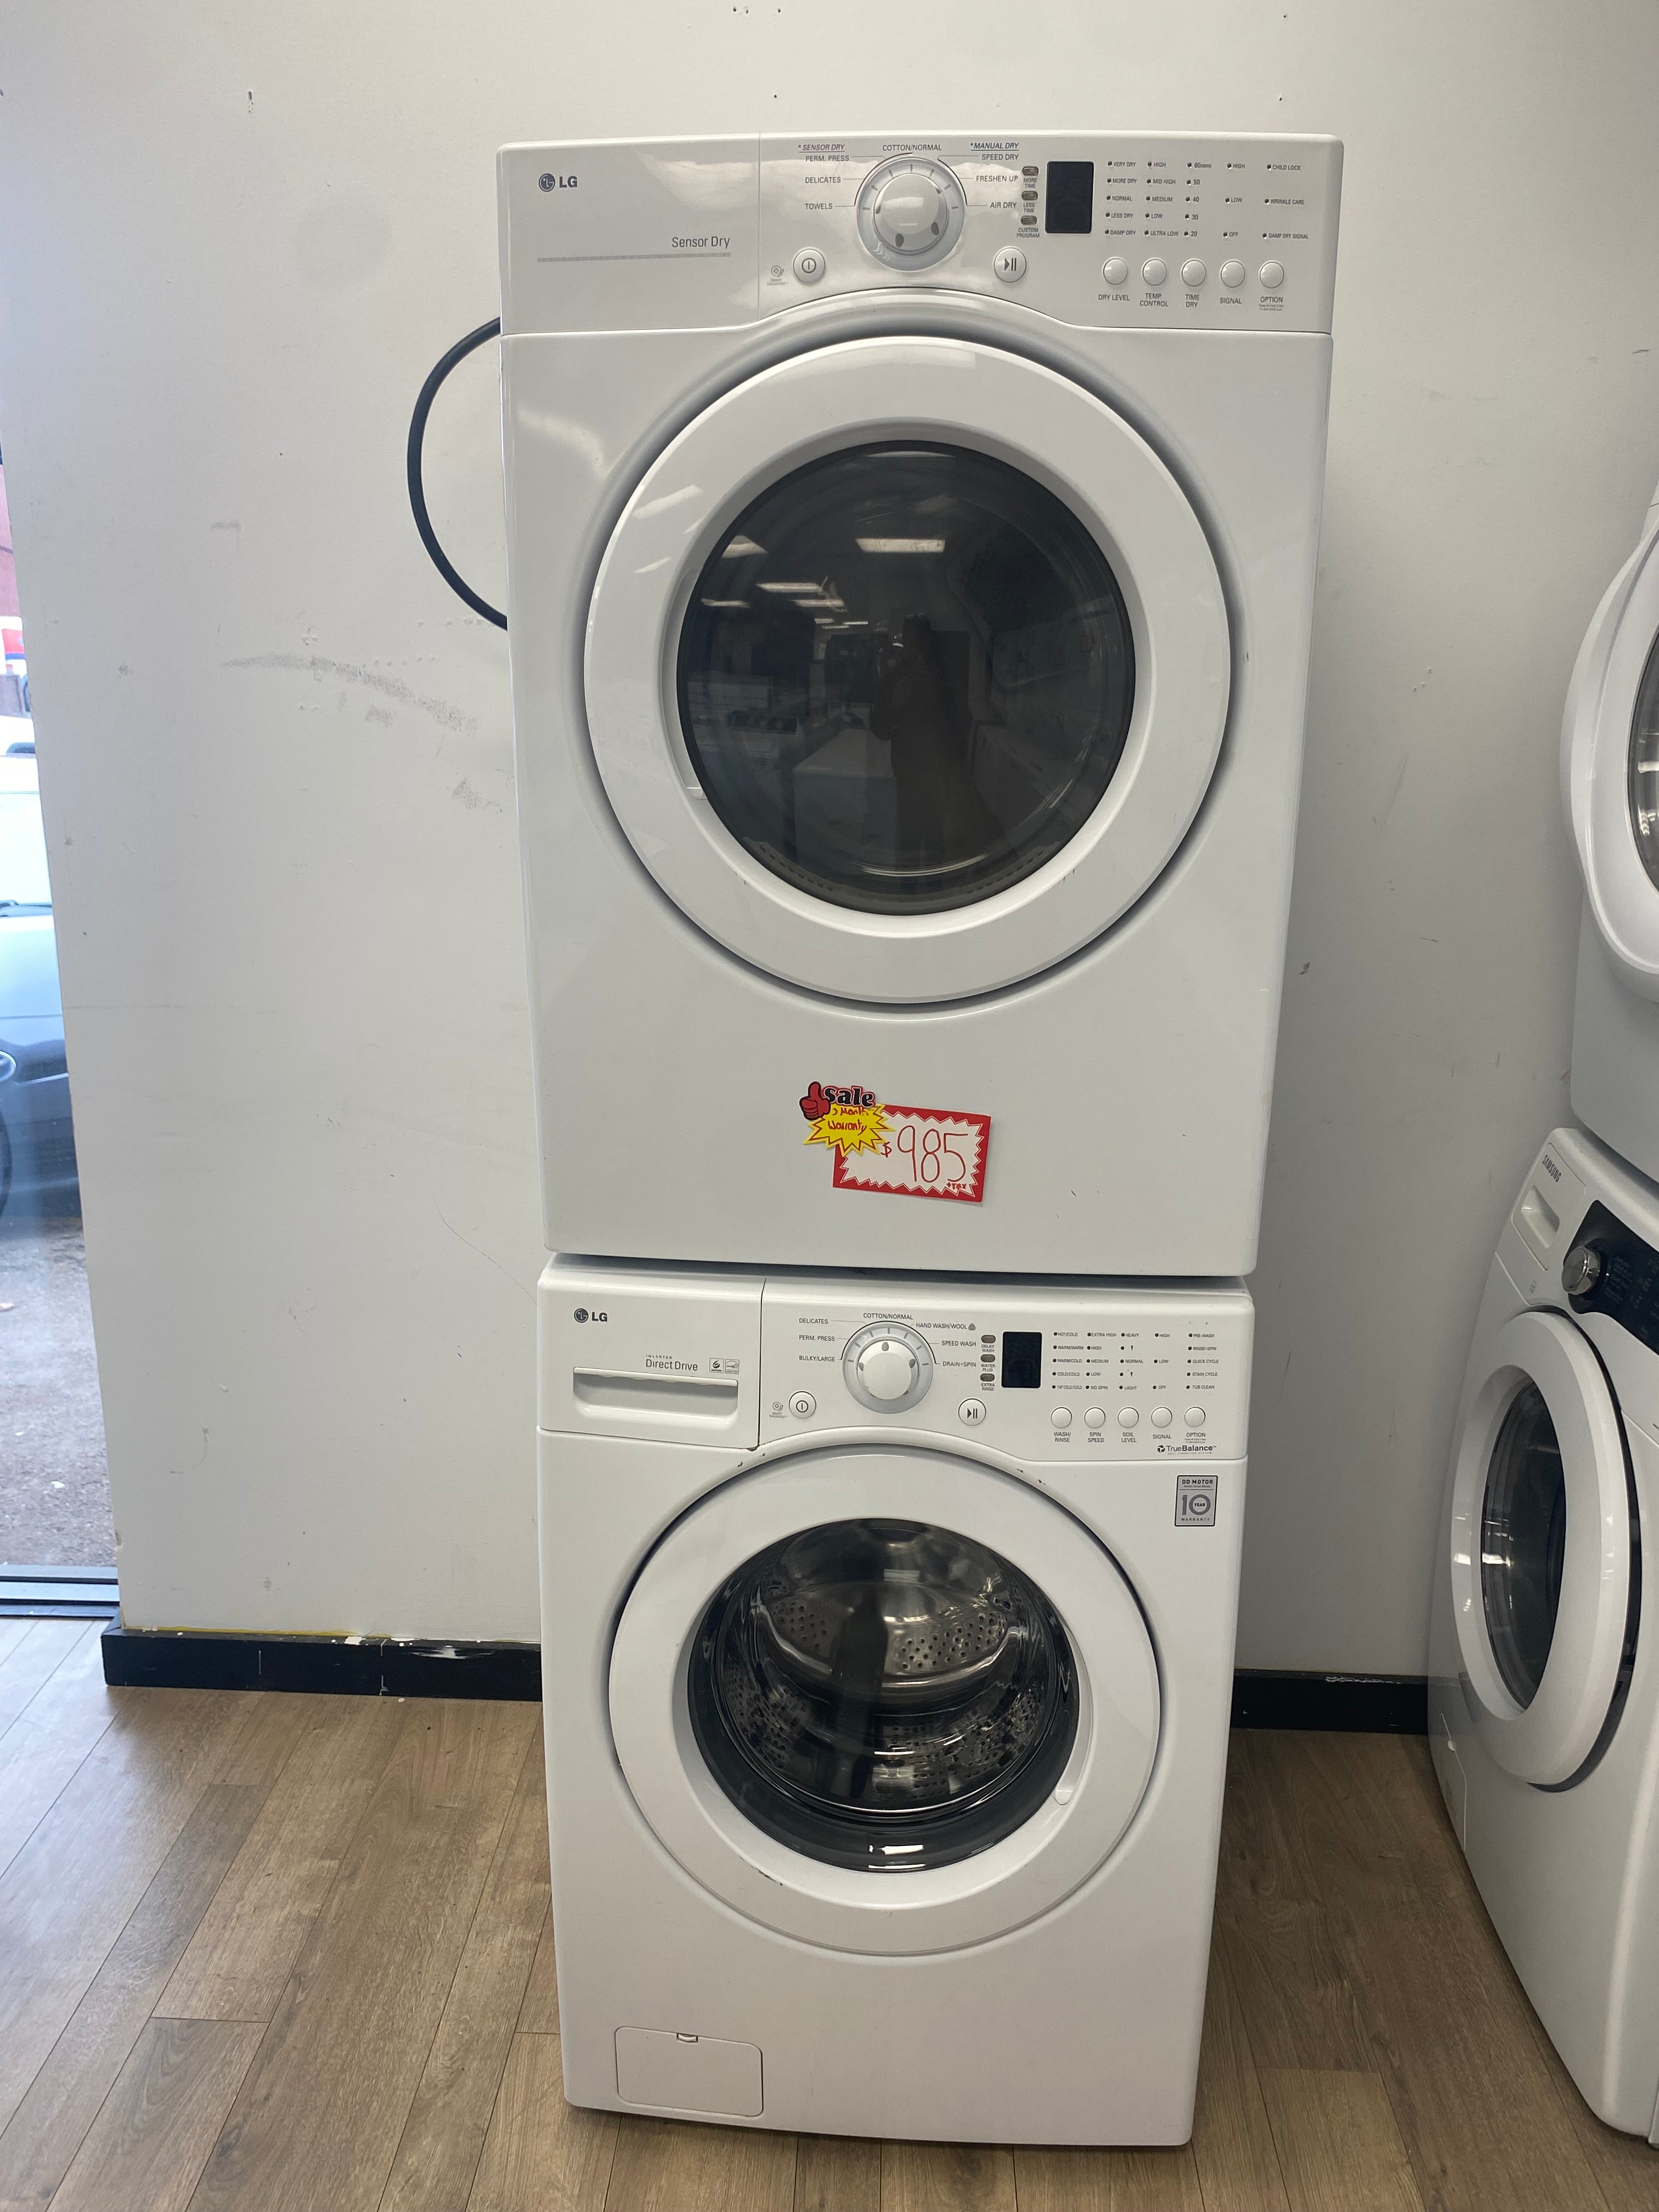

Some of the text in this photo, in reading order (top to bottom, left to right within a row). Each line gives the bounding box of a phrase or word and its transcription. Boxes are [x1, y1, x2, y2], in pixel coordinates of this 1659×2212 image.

[560, 176, 577, 188] LG
[672, 236, 730, 249] Sensor Dry
[828, 1119, 867, 1136] Warranty
[1542, 1155, 1561, 1182] SAMSUNG
[592, 1312, 607, 1322] LG
[646, 1359, 698, 1371] Direct Drive
[1182, 1494, 1210, 1515] 10
